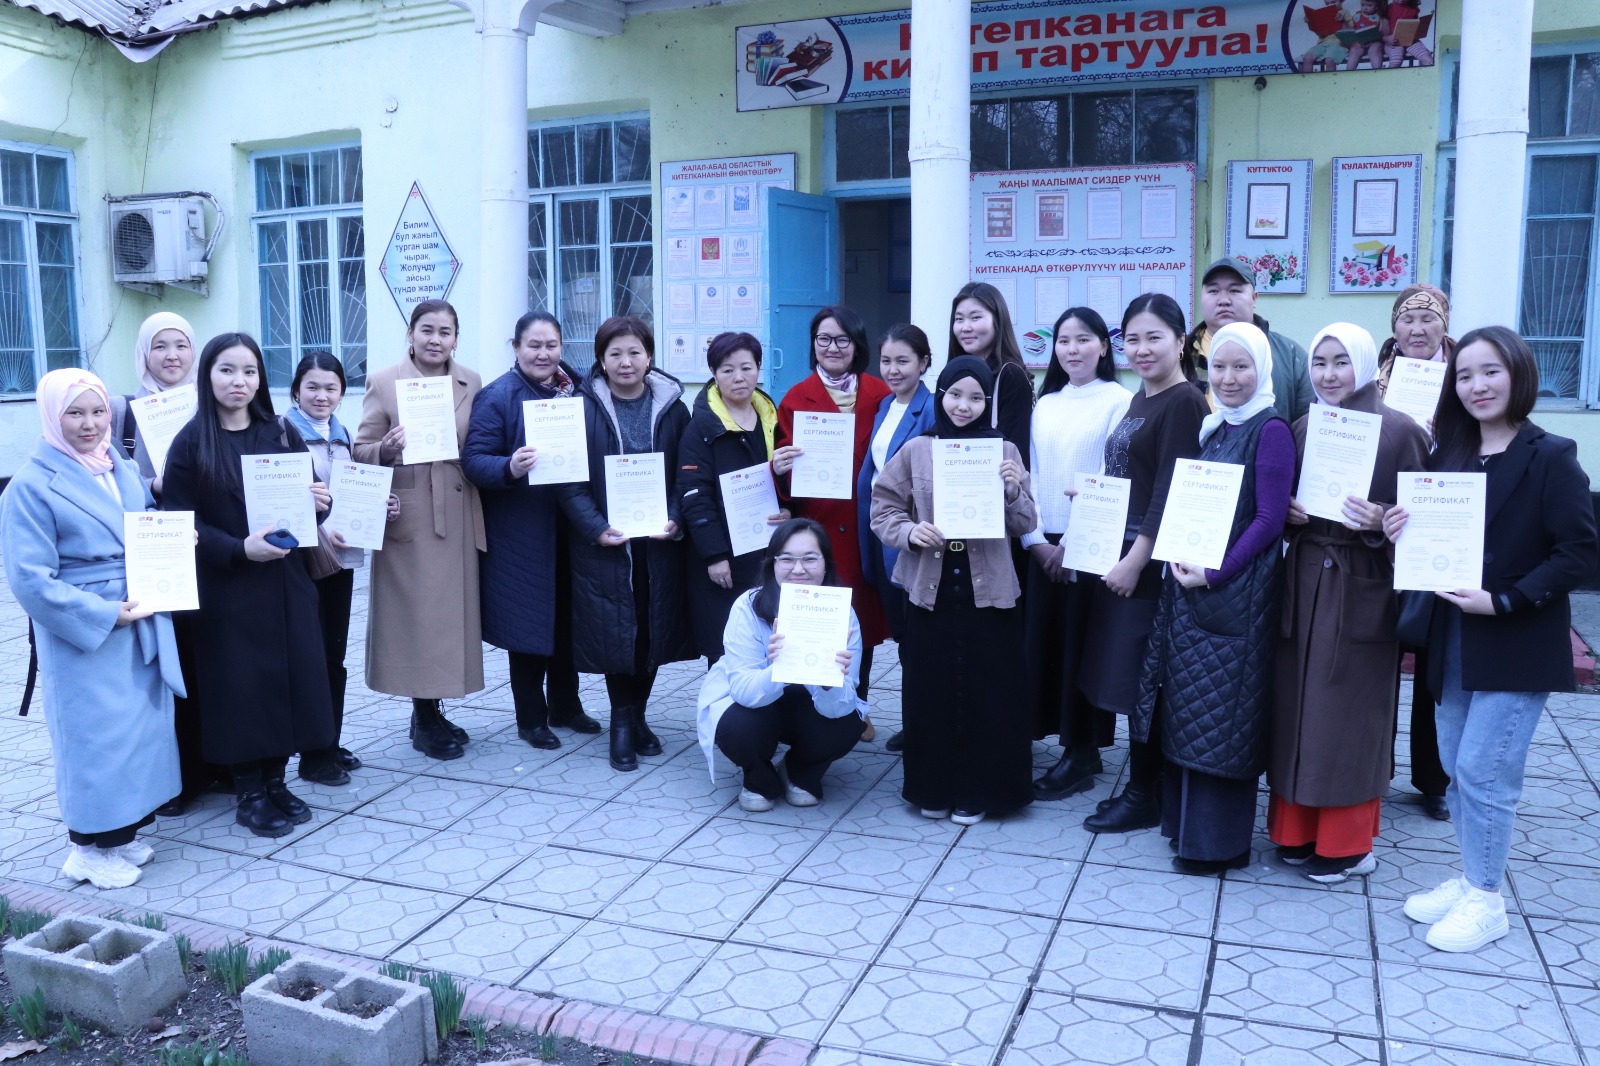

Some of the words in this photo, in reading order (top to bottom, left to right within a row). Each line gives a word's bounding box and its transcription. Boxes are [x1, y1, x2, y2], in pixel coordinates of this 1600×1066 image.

[900, 5, 1227, 51] тепканага
[863, 51, 999, 81] кип
[1016, 24, 1269, 72] тартуула!
[681, 162, 727, 172] ЖАЛАЛ-АБАД
[728, 160, 772, 169] ОБЛАСТТЫК
[1341, 161, 1413, 170] КУЛАКТАНДЫРУУ
[671, 172, 728, 181] КИТЕПКАНАНЫН
[998, 179, 1030, 189] ЖАҢЫ
[1031, 176, 1090, 187] МААЛЫМАТ
[1091, 175, 1131, 185] СИЗДЕР
[1134, 173, 1161, 183] ҮЧҮН
[403, 221, 430, 229] Билим
[395, 232, 410, 241] бул
[411, 231, 438, 240] жанып
[395, 243, 421, 253] турган
[422, 242, 440, 250] шам
[975, 264, 1044, 274] КИТЕПКАНАДА
[1119, 263, 1136, 271] ИШ
[1138, 262, 1186, 271] ЧАРАЛАР
[405, 274, 431, 282] айсыз
[418, 284, 445, 293] жарык
[1400, 376, 1442, 388] СЕРТИФИКА
[147, 403, 190, 420] СЕРТИФИКАТ
[1318, 427, 1367, 442] СЕРТИФИКАТ
[944, 458, 992, 466] СЕРТИФИКАТ
[255, 472, 301, 480] СЕРТИФИКАТ
[615, 469, 655, 478] СЕРТИФИКАТ
[340, 478, 382, 488] СЕРТИФИКАТ
[1182, 480, 1229, 491] СЕРТИФИКАТ
[1082, 493, 1120, 504] СЕРТИФИКАТ
[1411, 496, 1471, 505] СЕРТИФИКАТ
[137, 531, 183, 539] СЕРТИФИКАТ
[791, 604, 839, 613] СЕРТИФИКАТ
